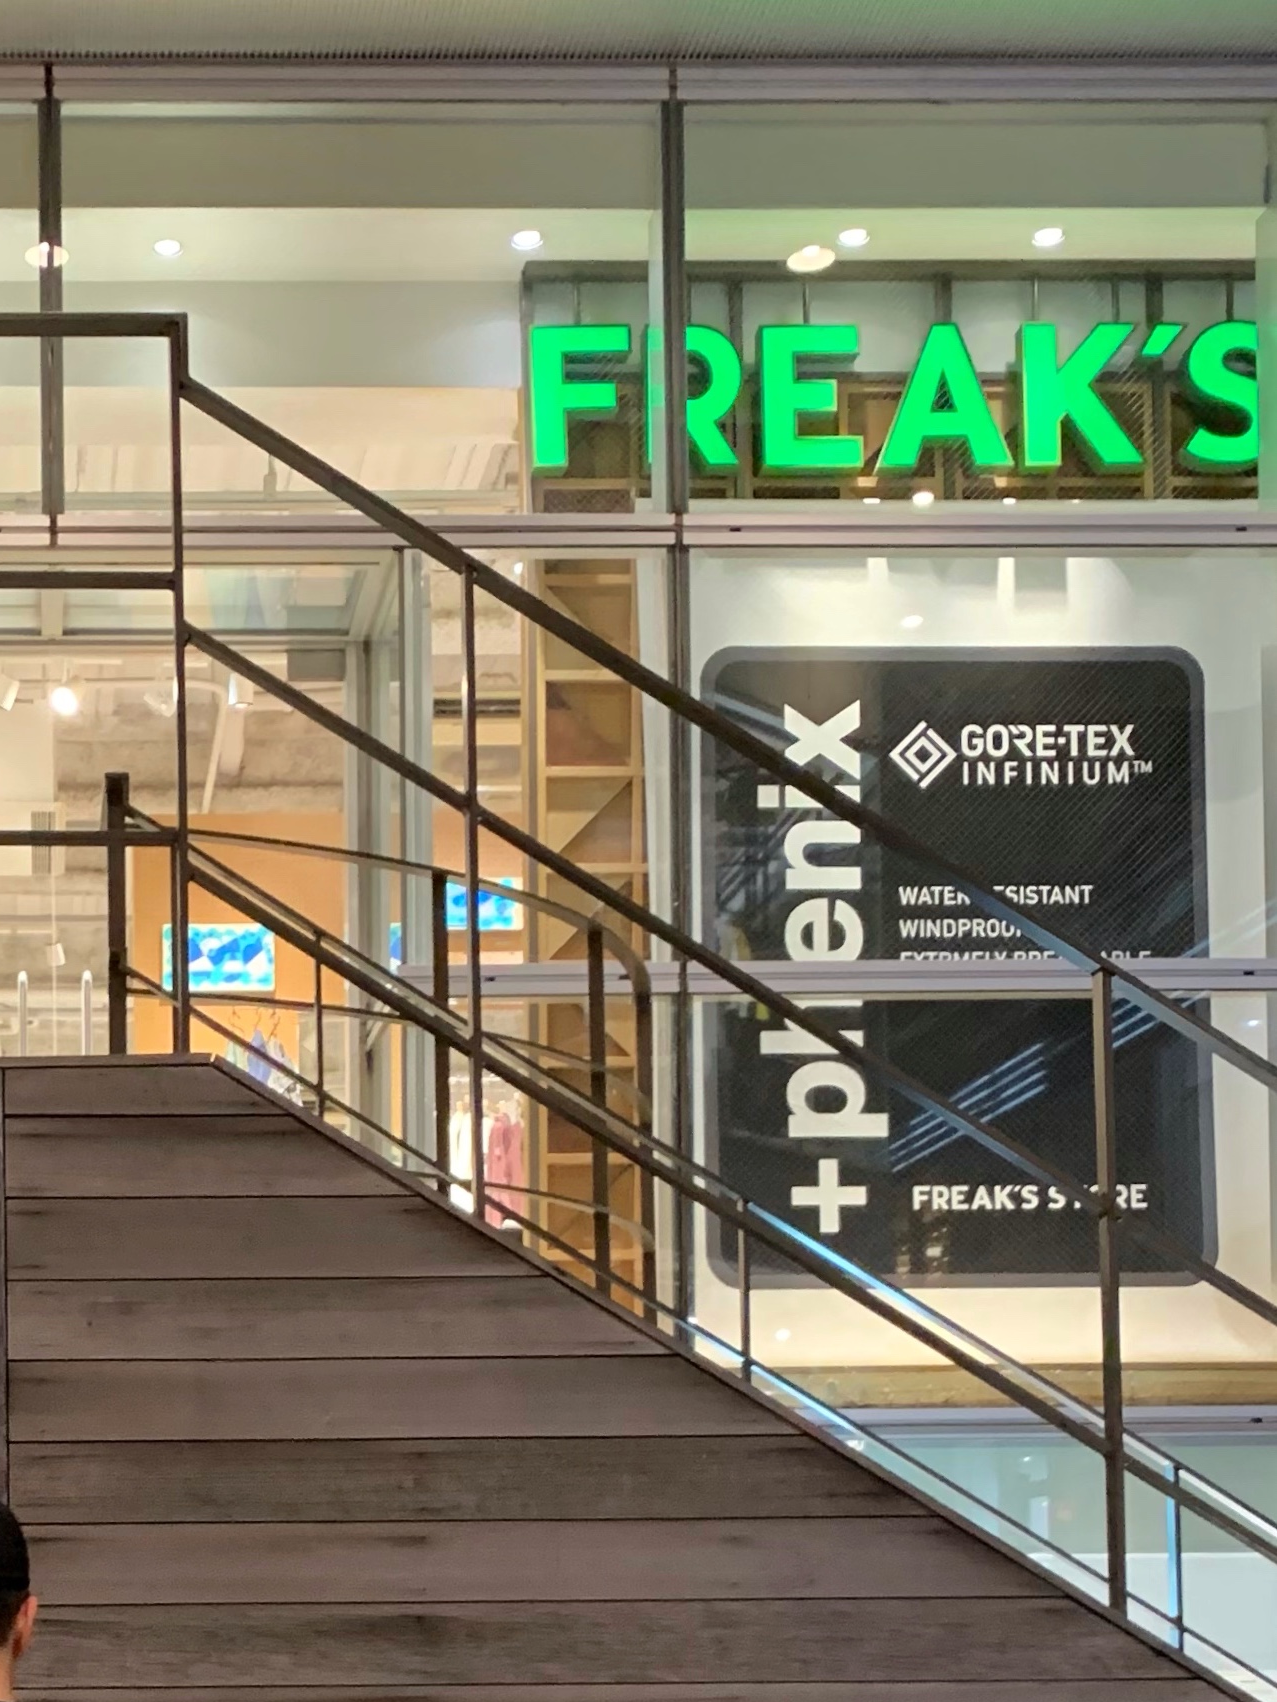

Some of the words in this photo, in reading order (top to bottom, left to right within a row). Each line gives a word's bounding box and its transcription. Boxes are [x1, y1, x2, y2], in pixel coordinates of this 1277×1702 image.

[529, 320, 1259, 474] FREAK'S
[911, 1184, 1040, 1212] FREAK'S
[1047, 1183, 1149, 1211] SRE
